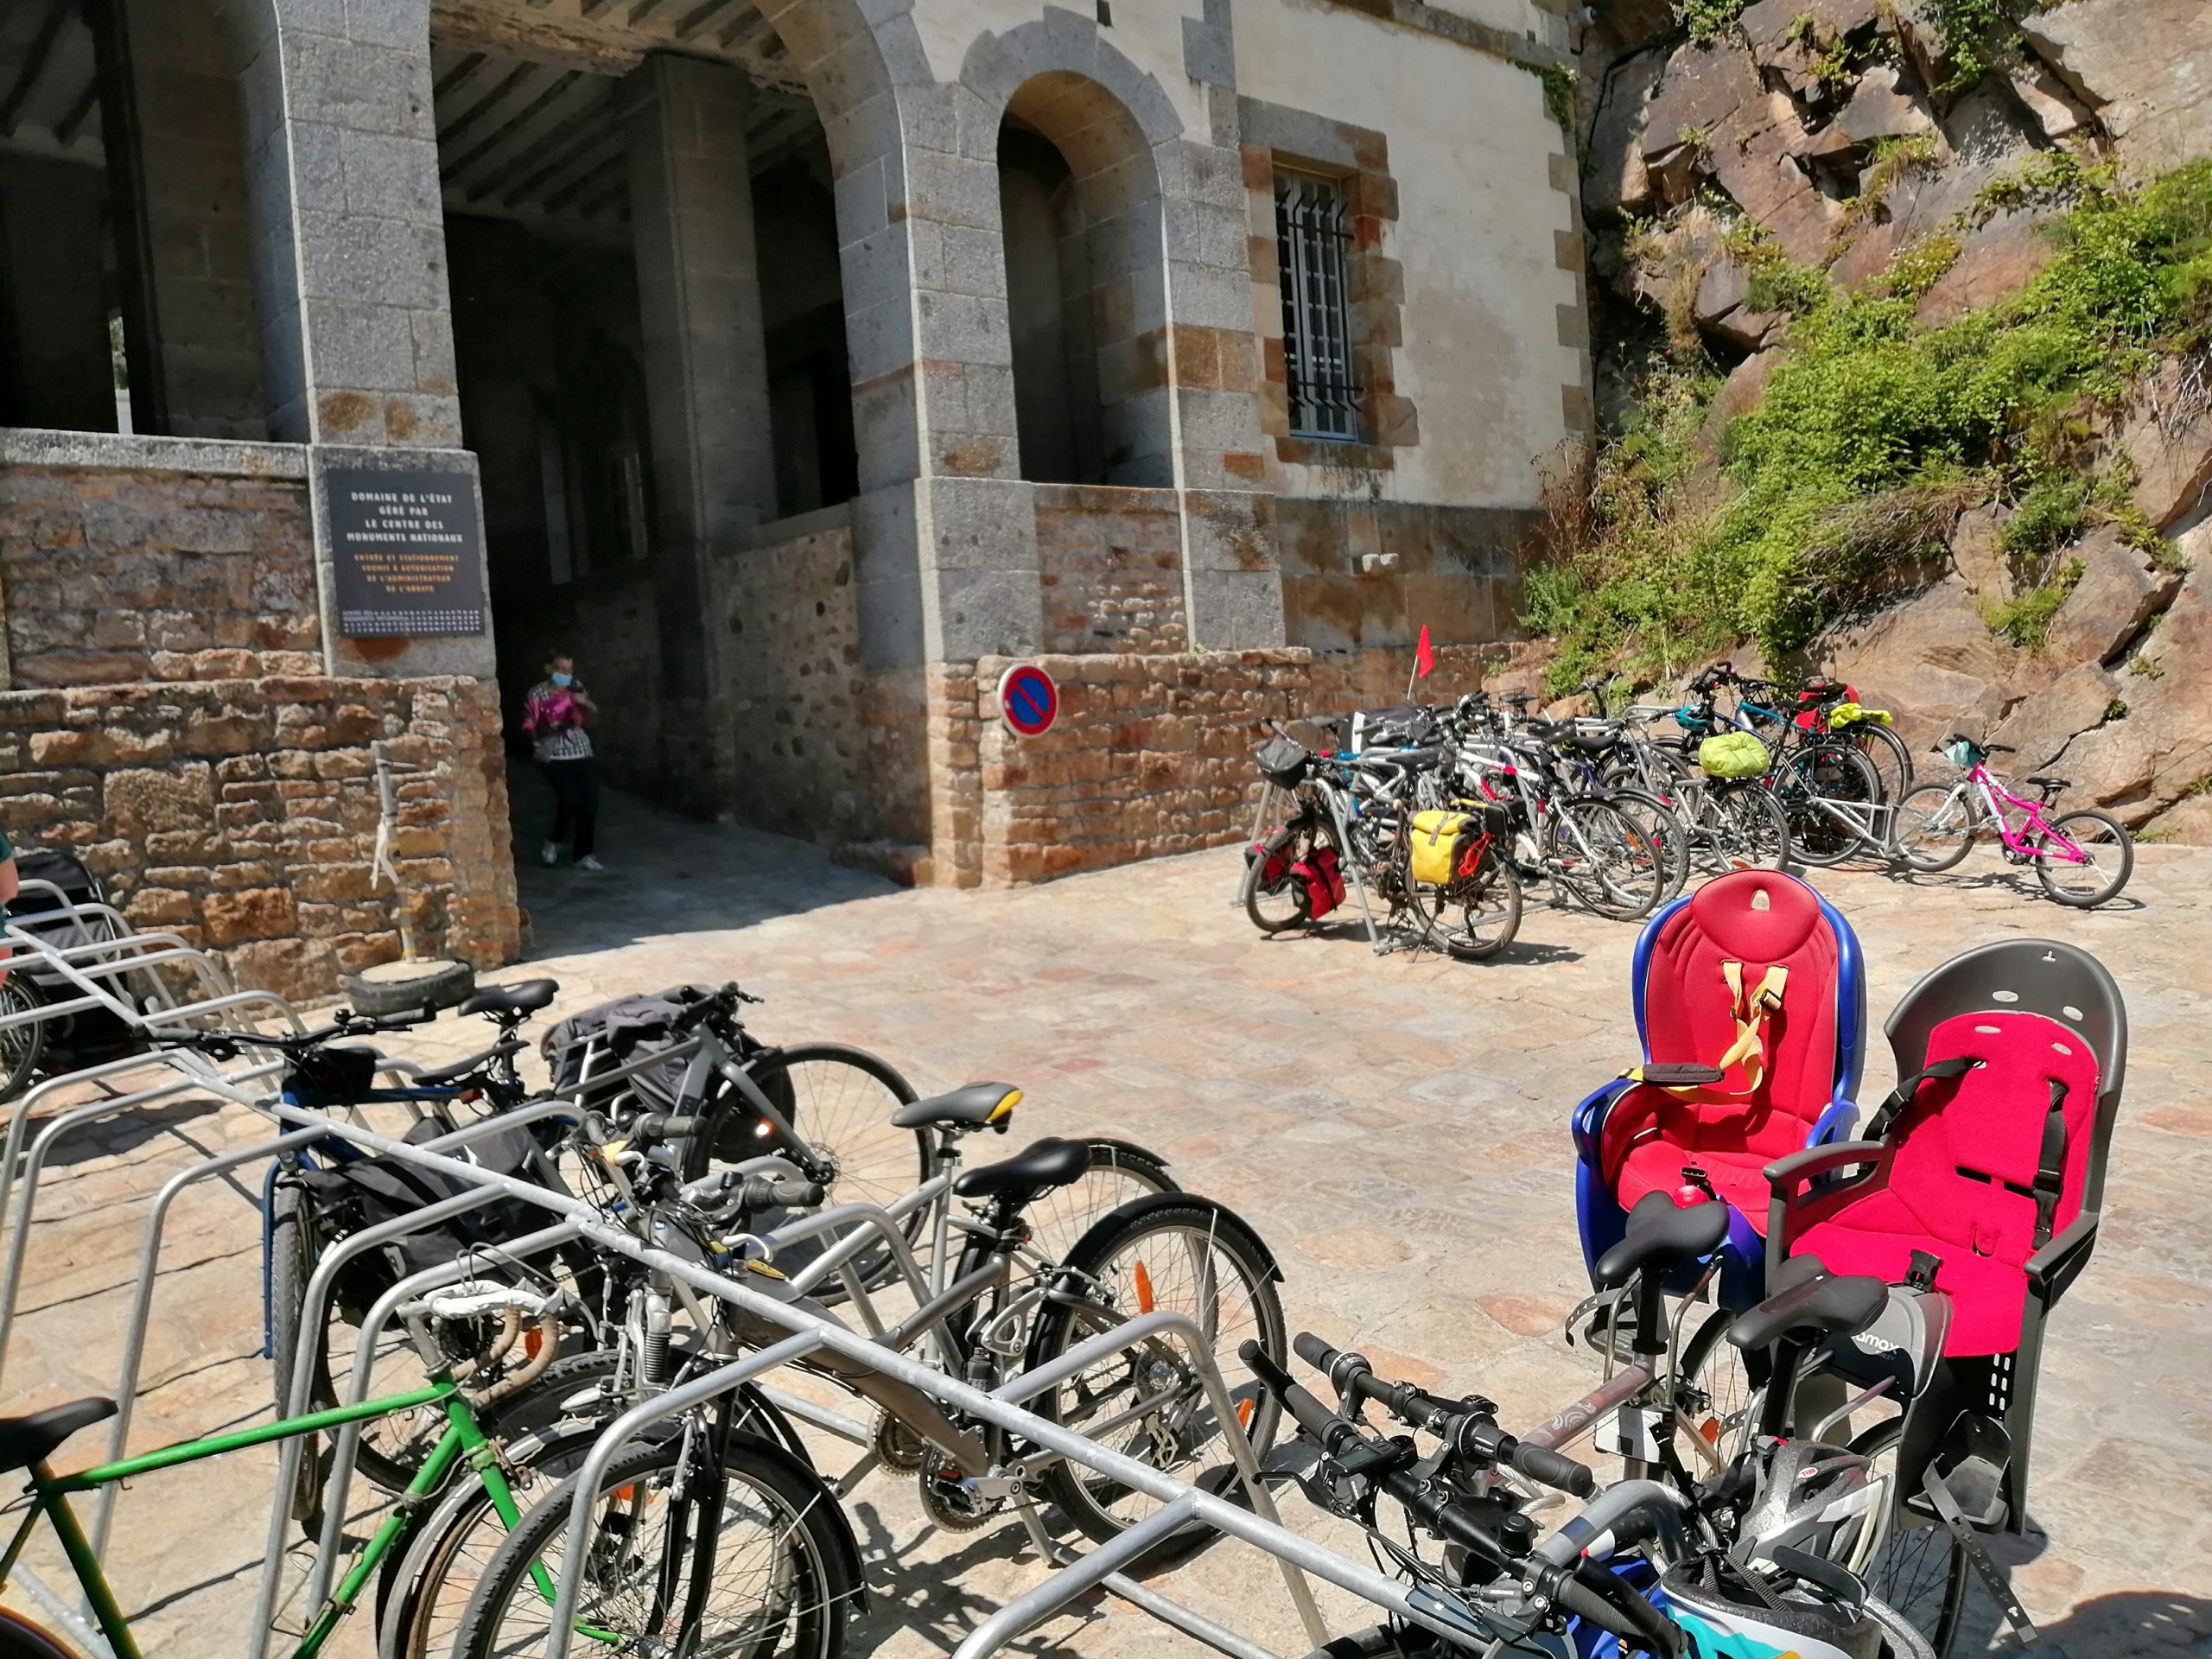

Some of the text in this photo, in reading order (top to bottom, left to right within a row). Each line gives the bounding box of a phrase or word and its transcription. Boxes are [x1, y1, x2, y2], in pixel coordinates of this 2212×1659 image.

[351, 492, 452, 503] DOMAINE DE L'ÉTAT
[378, 505, 429, 516] GÉRÉ PAR
[365, 518, 443, 529] LE CENTRE DES
[346, 532, 463, 543] MONUMENTS NATIONAUX
[1851, 1332, 1900, 1353] amax
